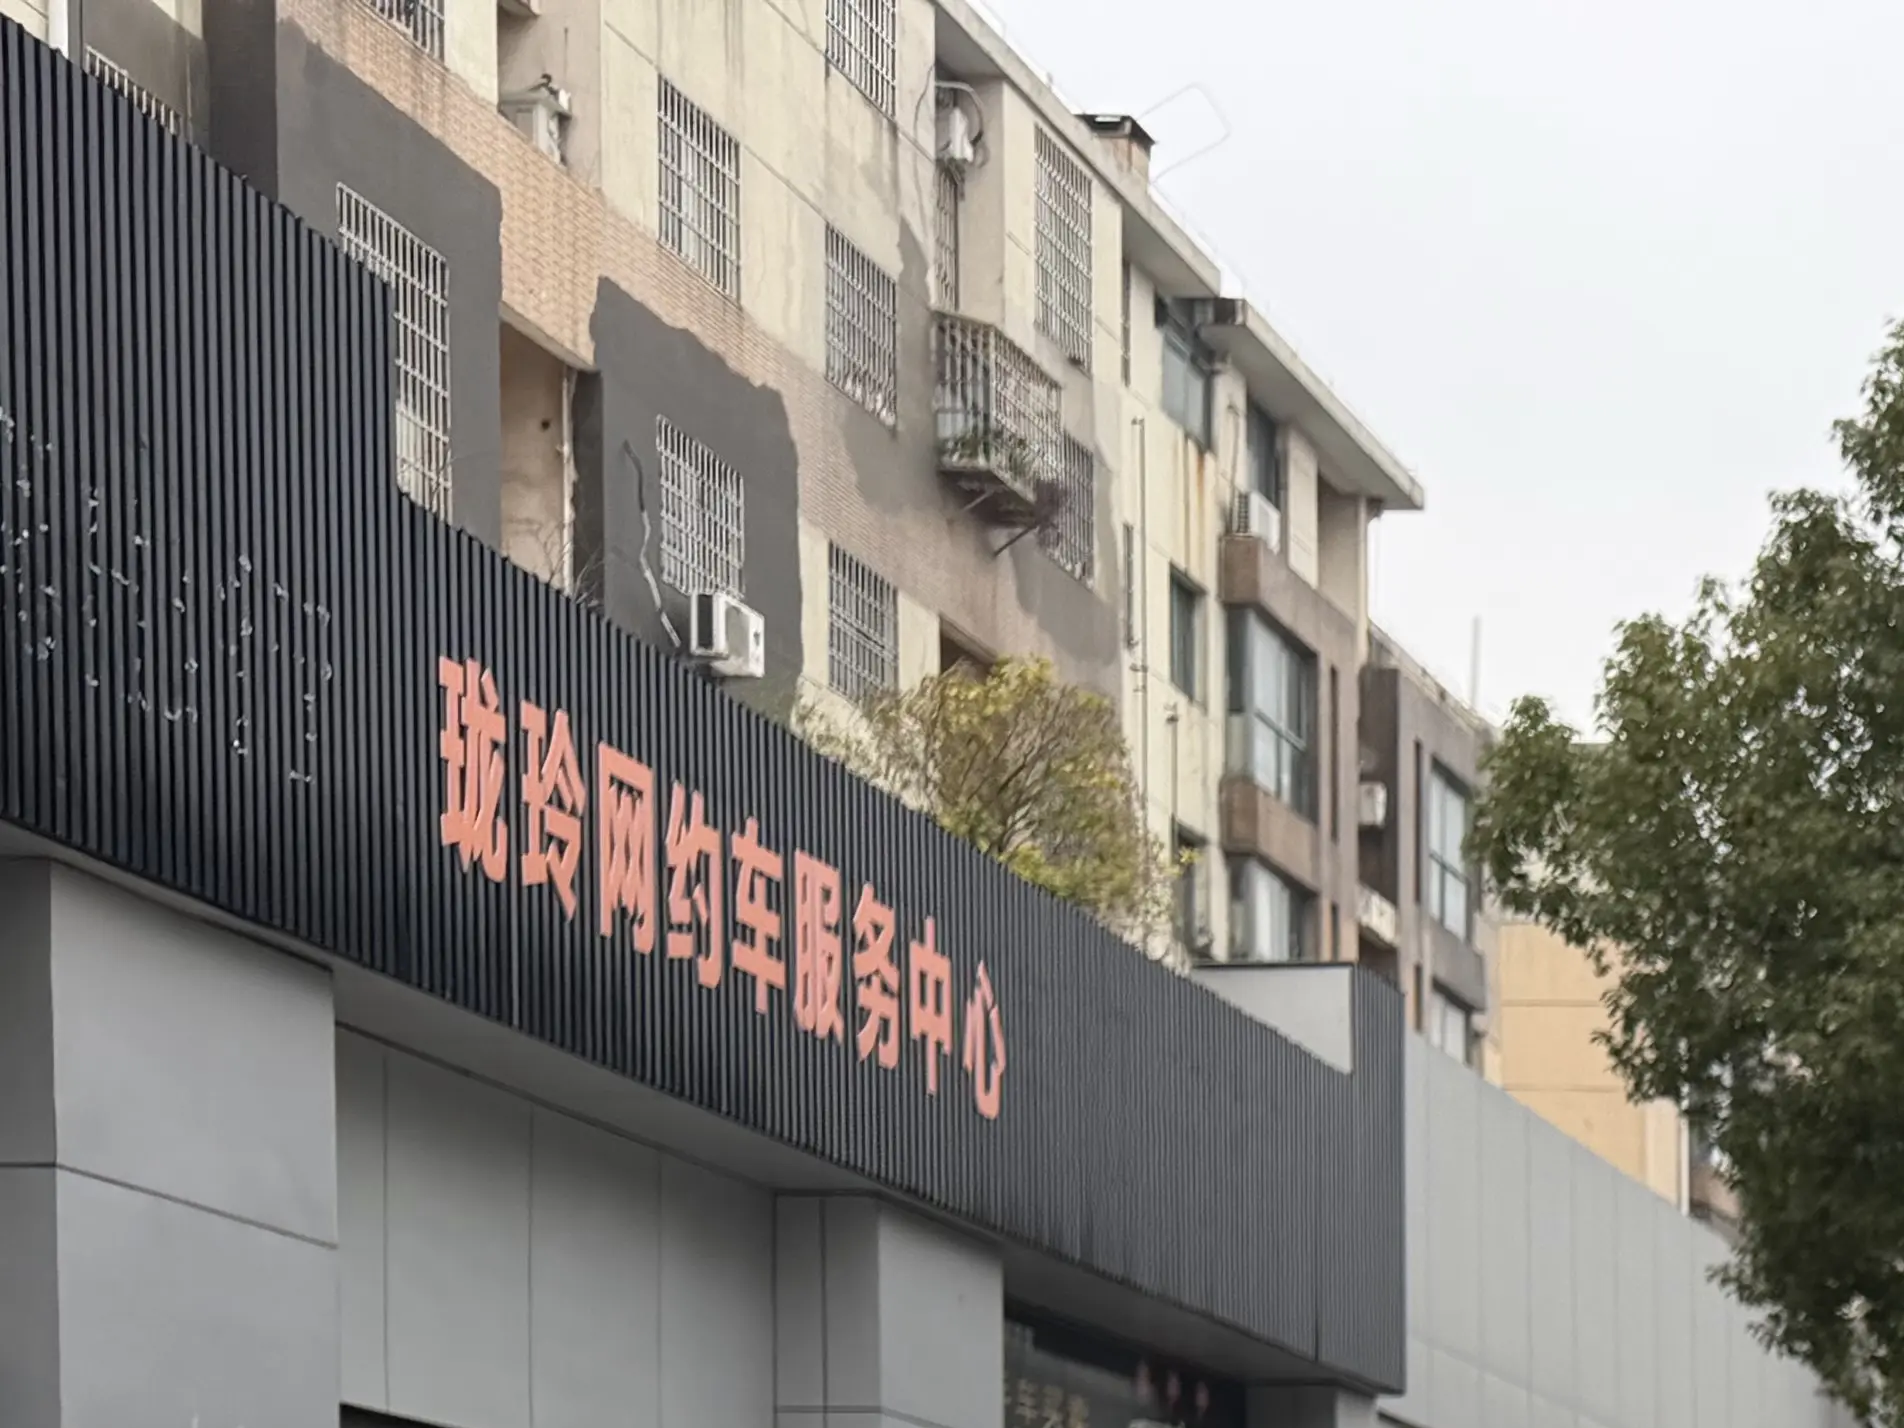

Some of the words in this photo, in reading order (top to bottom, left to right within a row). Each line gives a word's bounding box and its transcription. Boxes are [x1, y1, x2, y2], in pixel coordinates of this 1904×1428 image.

[438, 655, 1006, 1120] 珑玲网约车服务中心
